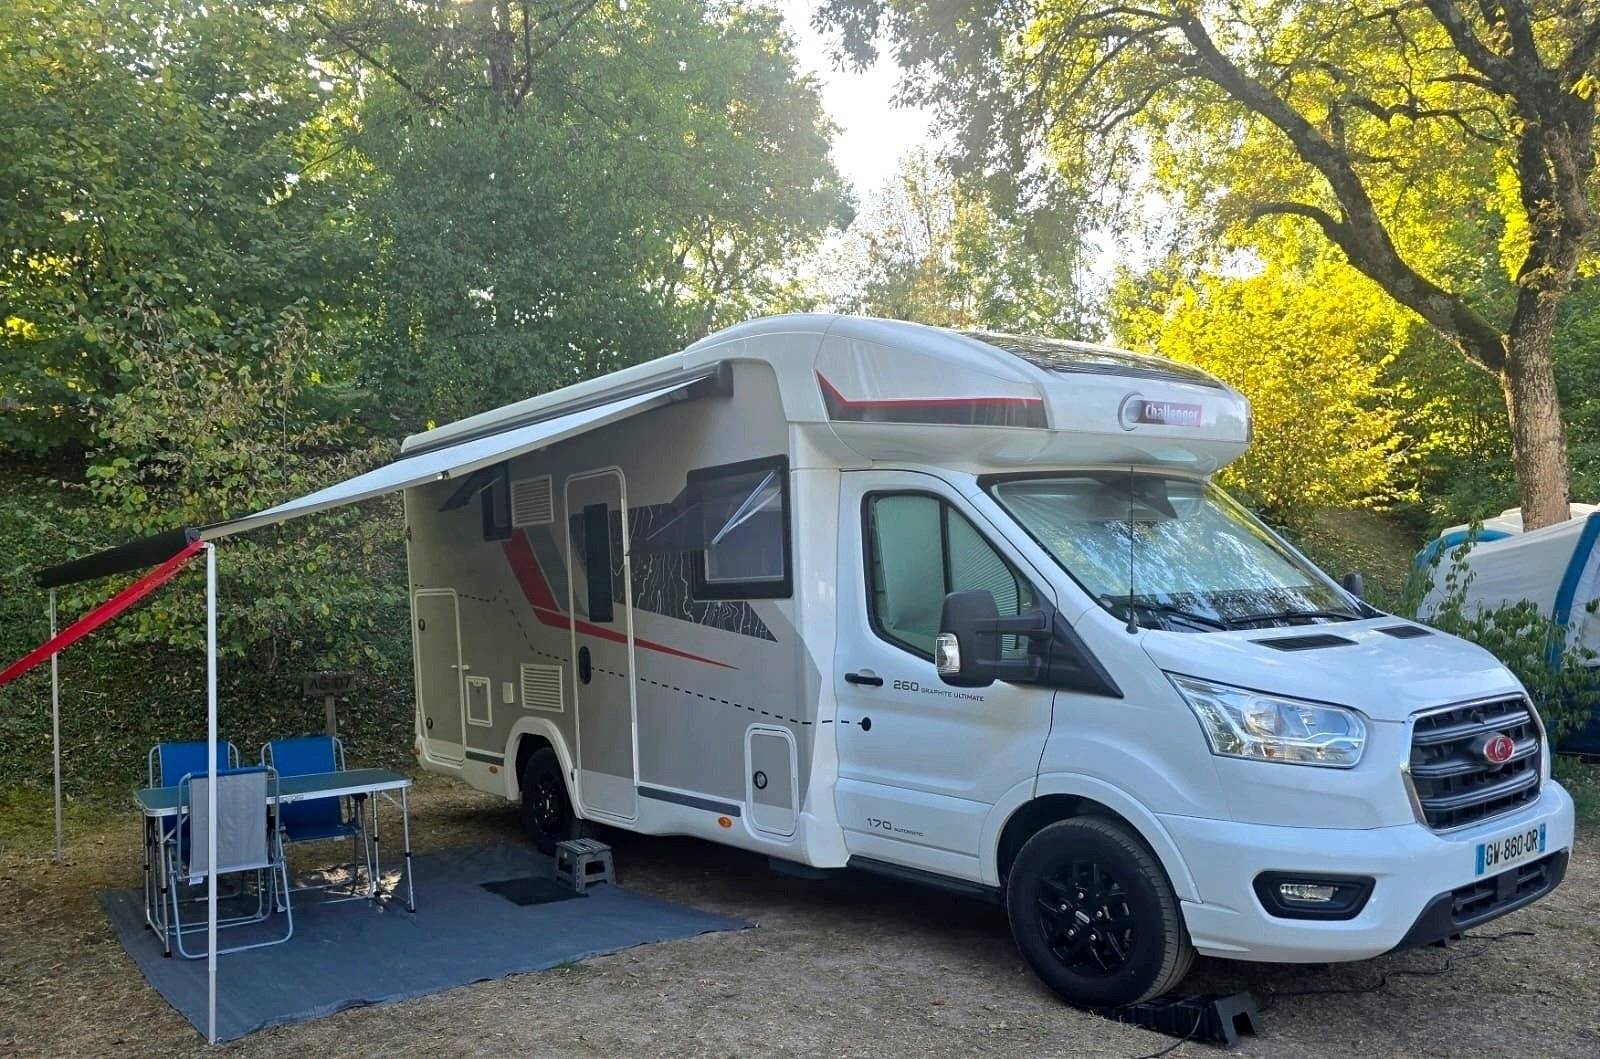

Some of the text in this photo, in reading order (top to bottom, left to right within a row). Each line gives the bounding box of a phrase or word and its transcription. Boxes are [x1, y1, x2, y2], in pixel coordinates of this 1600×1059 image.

[893, 679, 919, 692] 260
[954, 691, 985, 702] ULTIMATE
[867, 818, 892, 831] 170
